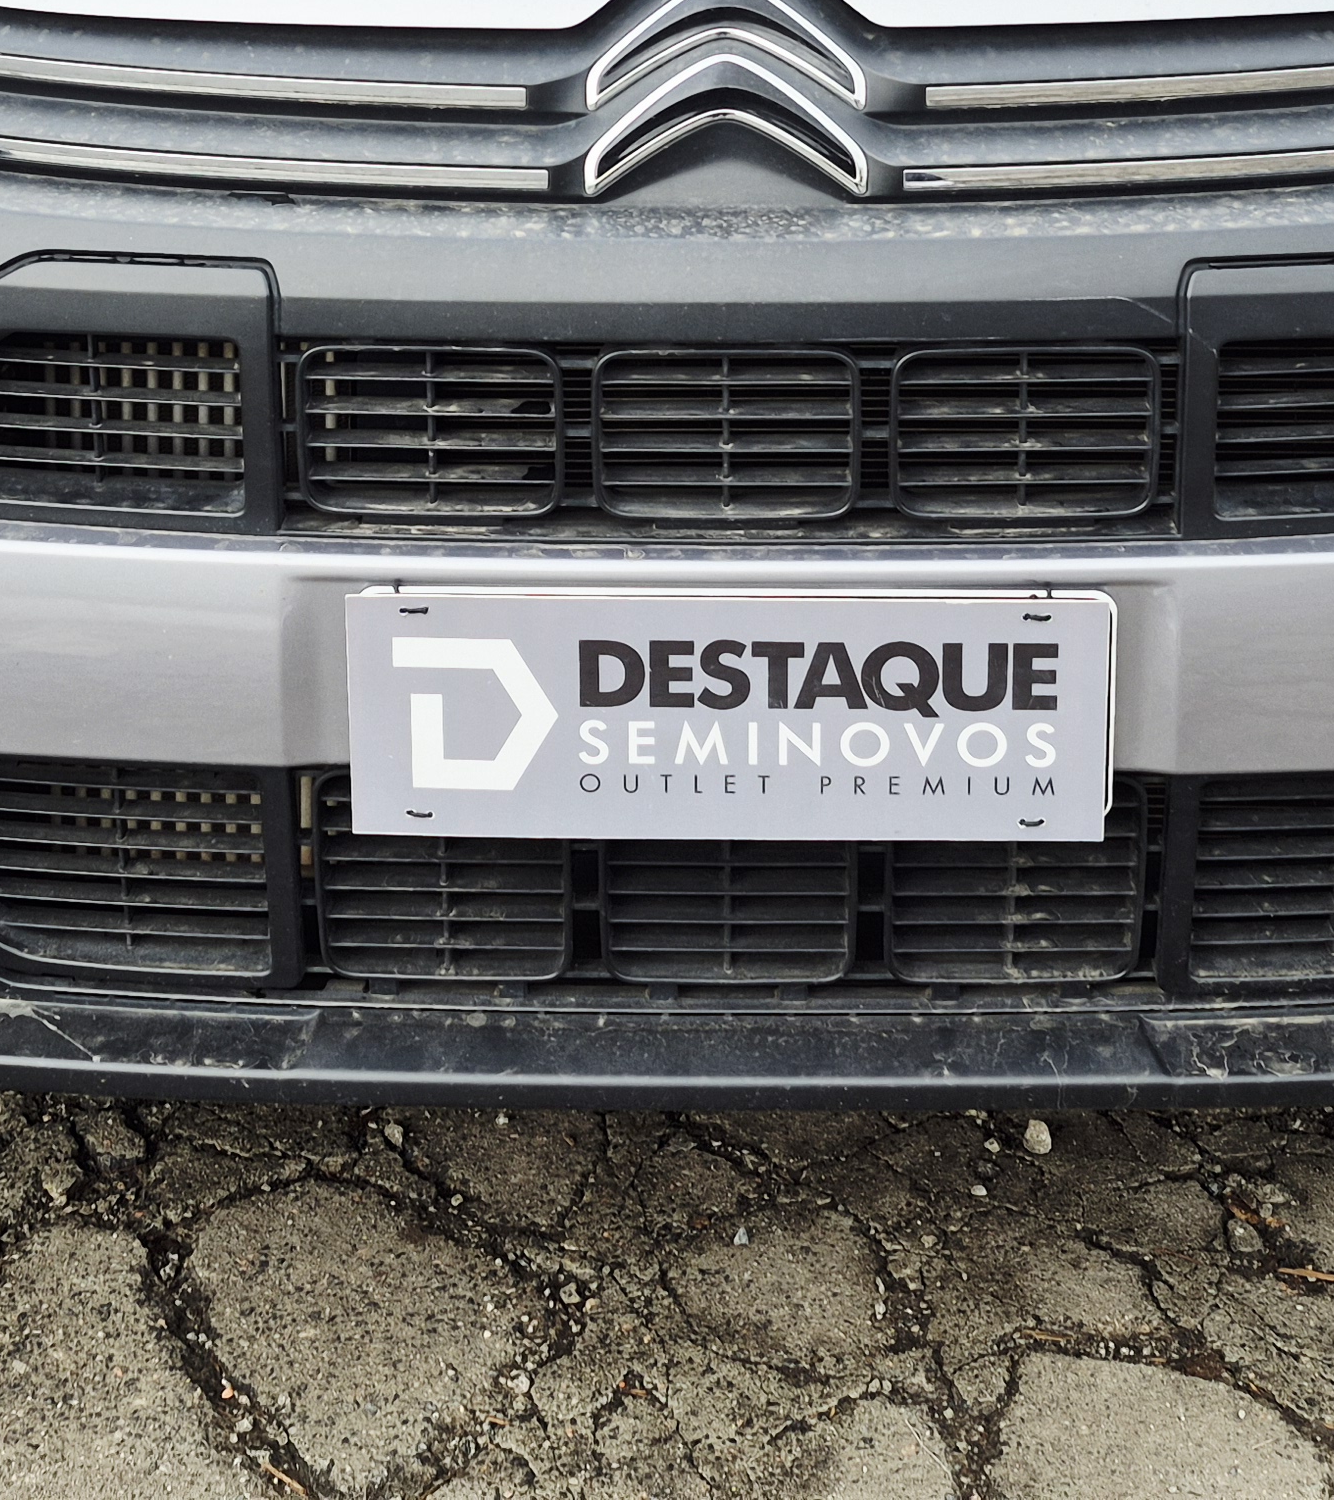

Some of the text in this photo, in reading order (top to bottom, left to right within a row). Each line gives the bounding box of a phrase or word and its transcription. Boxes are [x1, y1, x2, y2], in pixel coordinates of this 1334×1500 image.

[577, 637, 1060, 718] DESTAQUE
[578, 718, 1058, 768] SEMINOVOS
[578, 772, 1057, 798] OUTLET PREMIUM
